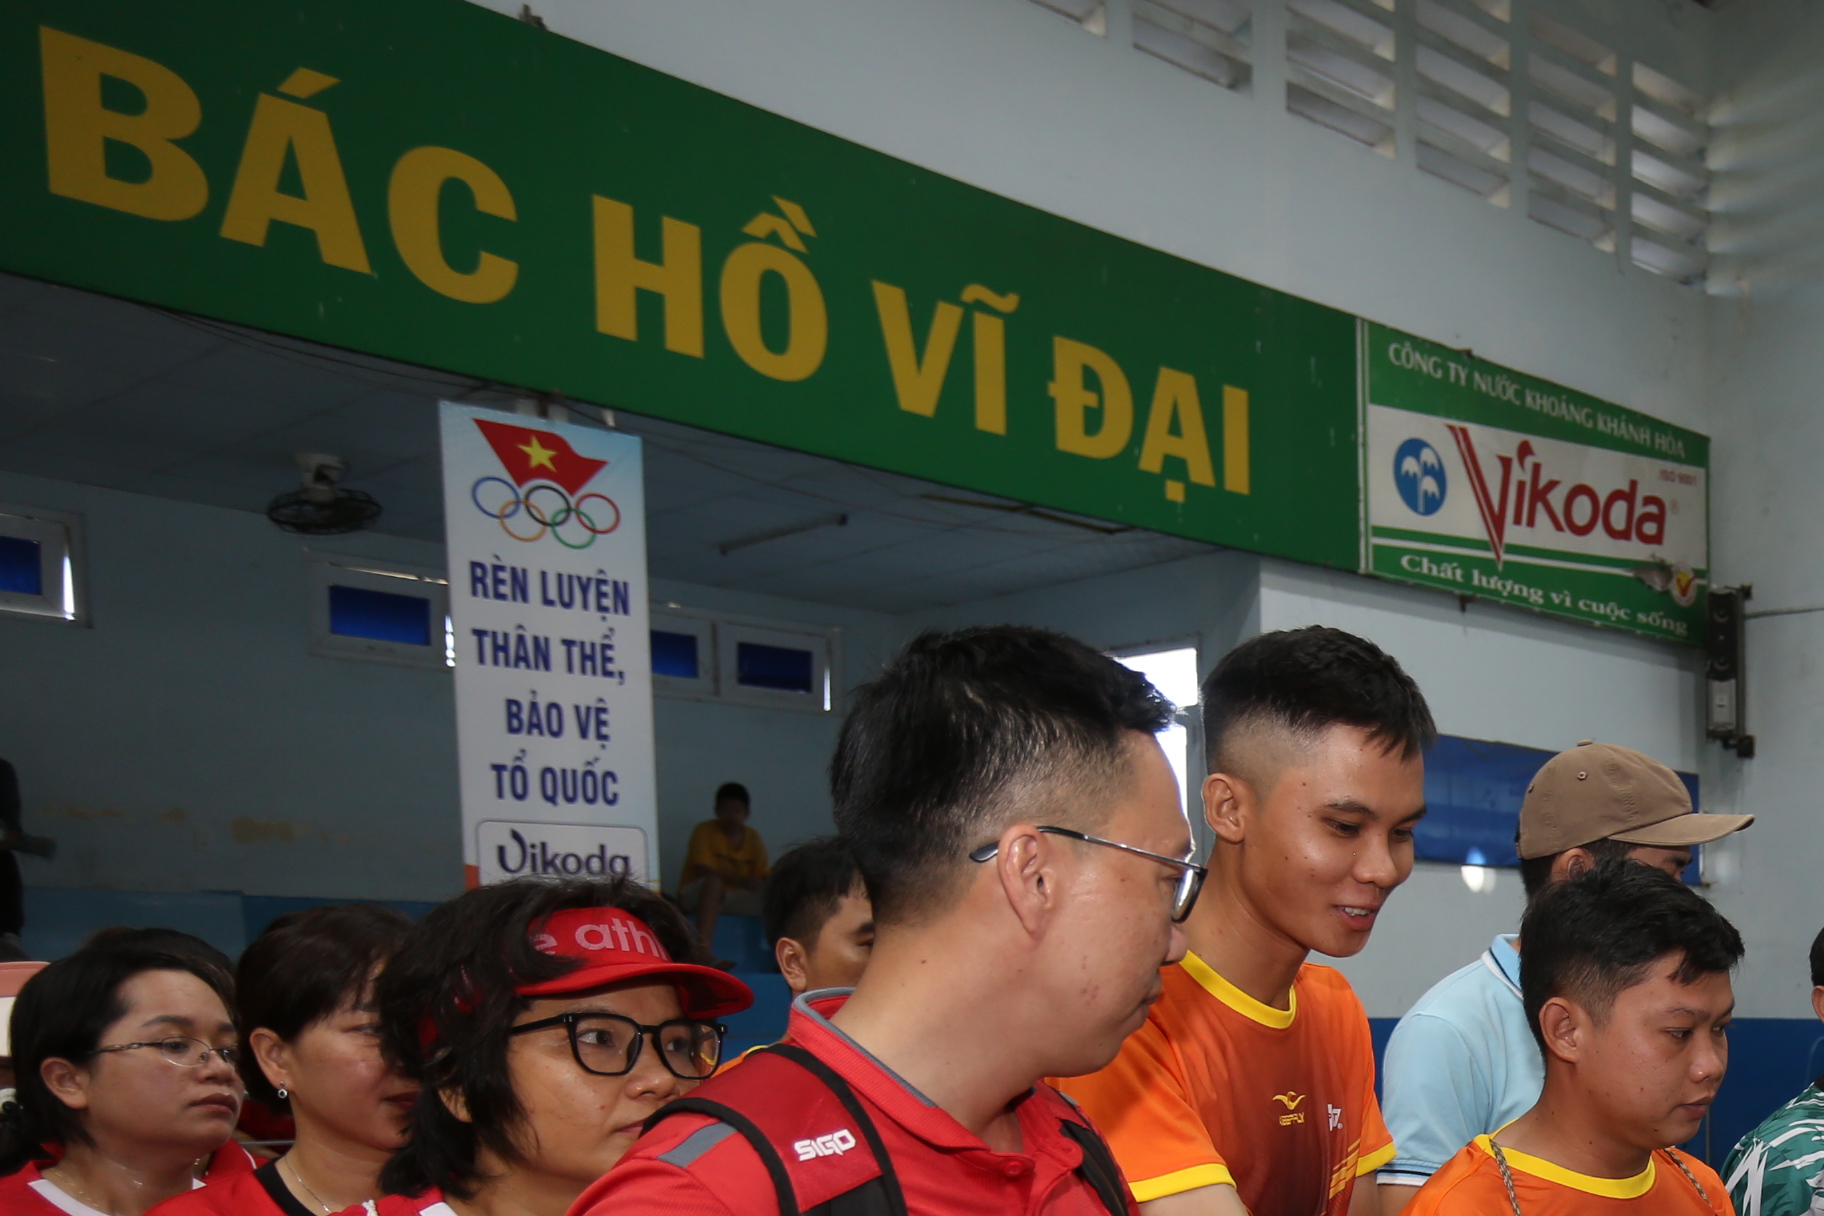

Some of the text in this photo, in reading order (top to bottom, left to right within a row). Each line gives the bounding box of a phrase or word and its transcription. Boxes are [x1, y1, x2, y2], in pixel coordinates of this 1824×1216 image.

[38, 24, 1251, 504] BÁC HỒ VĨ ĐẠI
[1388, 341, 1686, 459] CÔNG TY NƯỚC KHOÁNG KHÁNH HÒA
[1445, 424, 1667, 571] Vikoda
[469, 554, 631, 622] RÈN LUYỆN
[1400, 552, 1688, 637] Chất lượng vì cuộc sống
[472, 624, 552, 673] THÂN
[505, 689, 611, 749] BẢO VỆ
[491, 748, 620, 807] TỔ QUỐC
